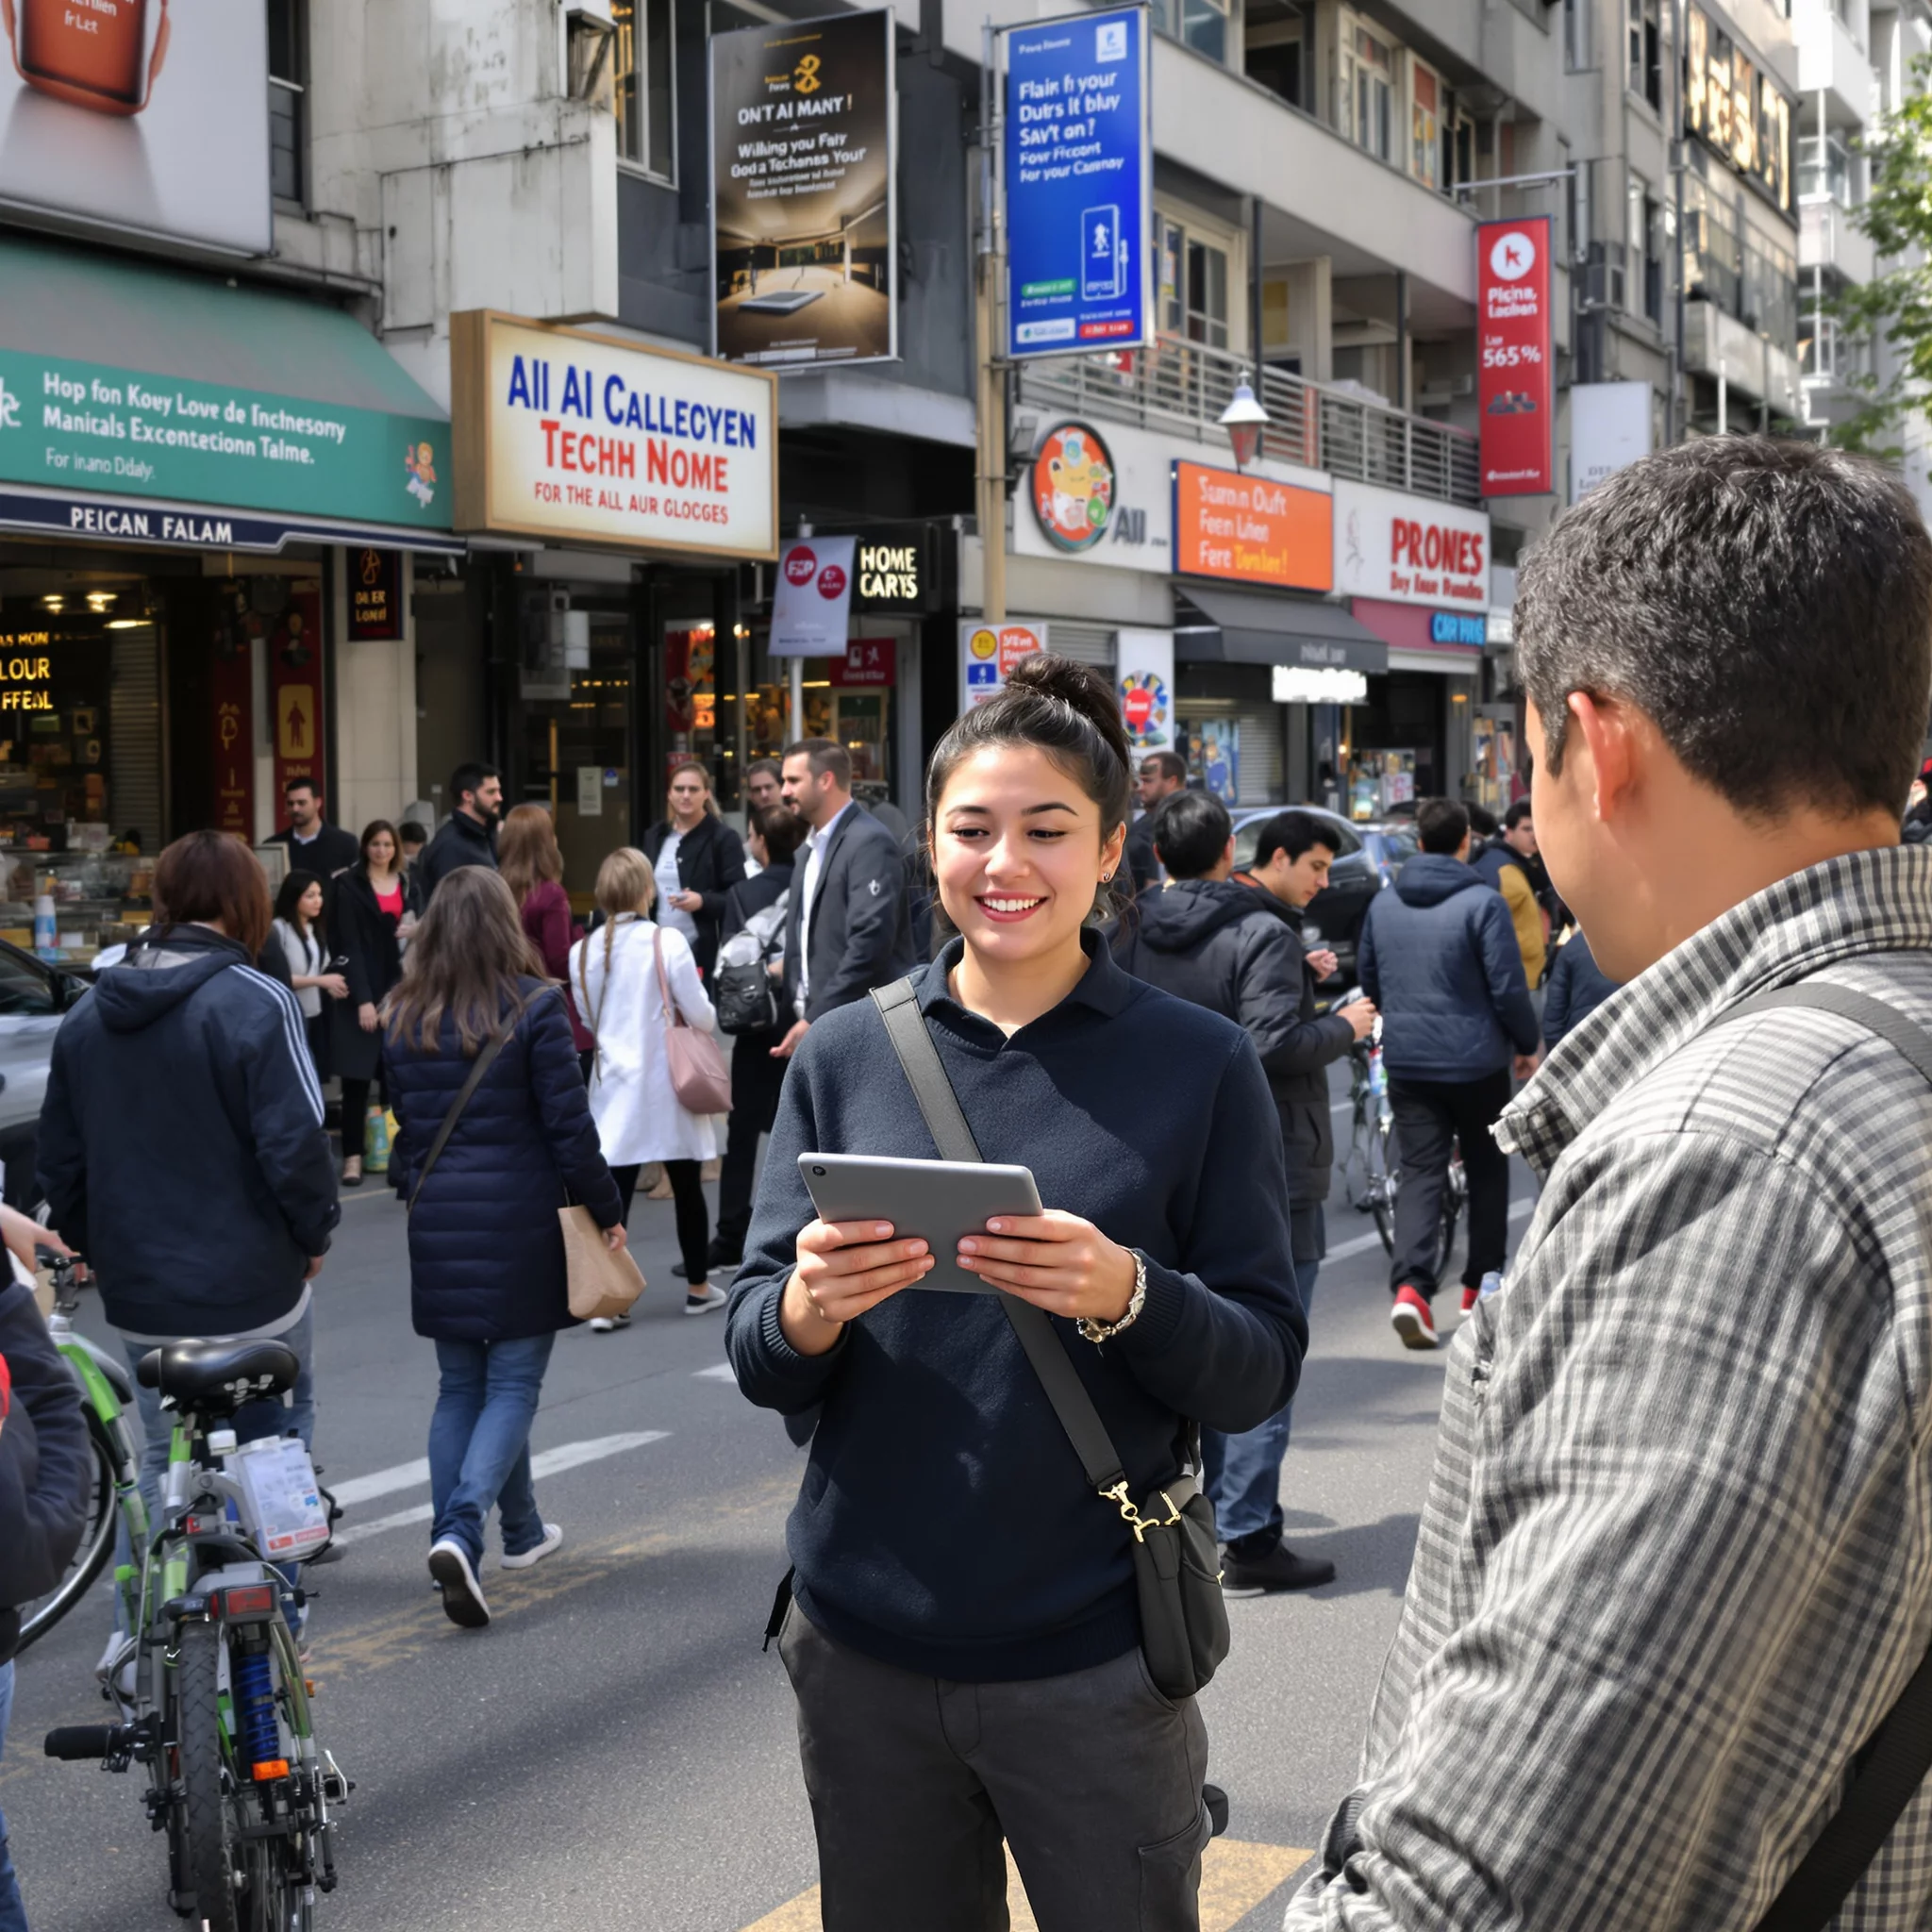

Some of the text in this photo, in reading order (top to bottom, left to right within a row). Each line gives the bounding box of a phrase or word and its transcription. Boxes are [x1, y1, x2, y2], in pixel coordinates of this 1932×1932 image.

[797, 95, 844, 117] MANY
[791, 138, 815, 154] you
[43, 372, 86, 405] Hop
[176, 391, 220, 420] Love
[45, 447, 69, 468] For
[647, 437, 729, 493] NOME
[534, 481, 562, 504] FOR
[566, 484, 593, 508] THE
[598, 490, 624, 512] ALL
[628, 493, 658, 516] AUR
[162, 516, 233, 544] FALAM
[859, 545, 917, 573] HOME
[1391, 517, 1483, 577] PRONES
